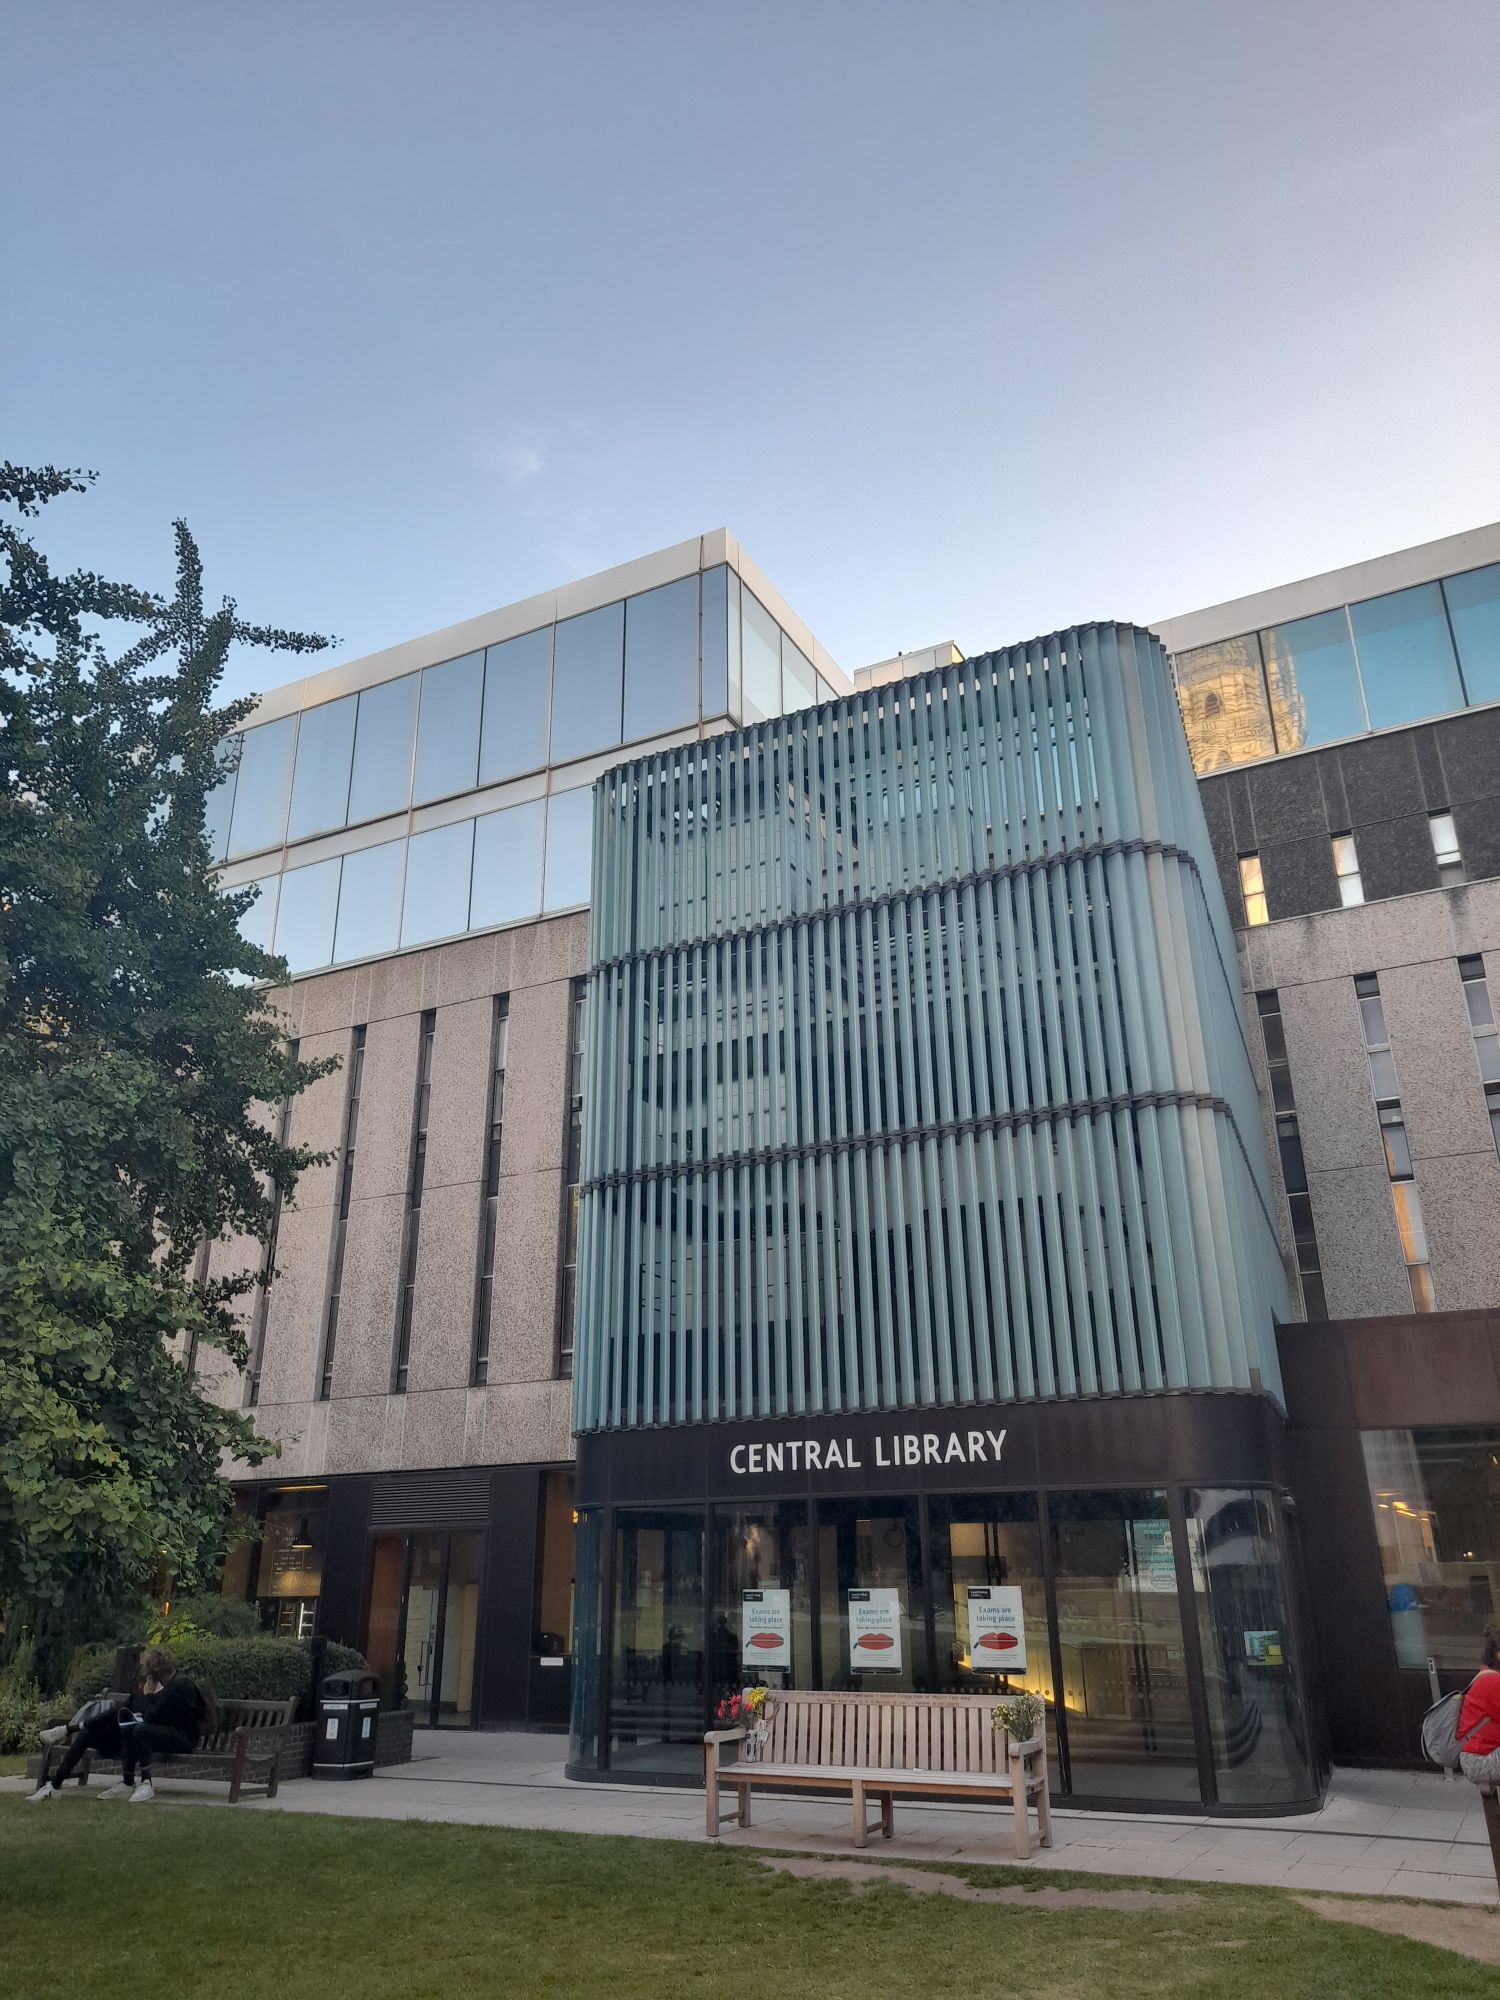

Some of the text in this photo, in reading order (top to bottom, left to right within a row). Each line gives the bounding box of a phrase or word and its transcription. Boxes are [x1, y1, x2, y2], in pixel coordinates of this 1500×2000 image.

[730, 1429, 1007, 1474] CENTRAL LIBRARY
[749, 1616, 783, 1624] taking place
[856, 1616, 893, 1624] taking place
[976, 1615, 1016, 1623] taking place
